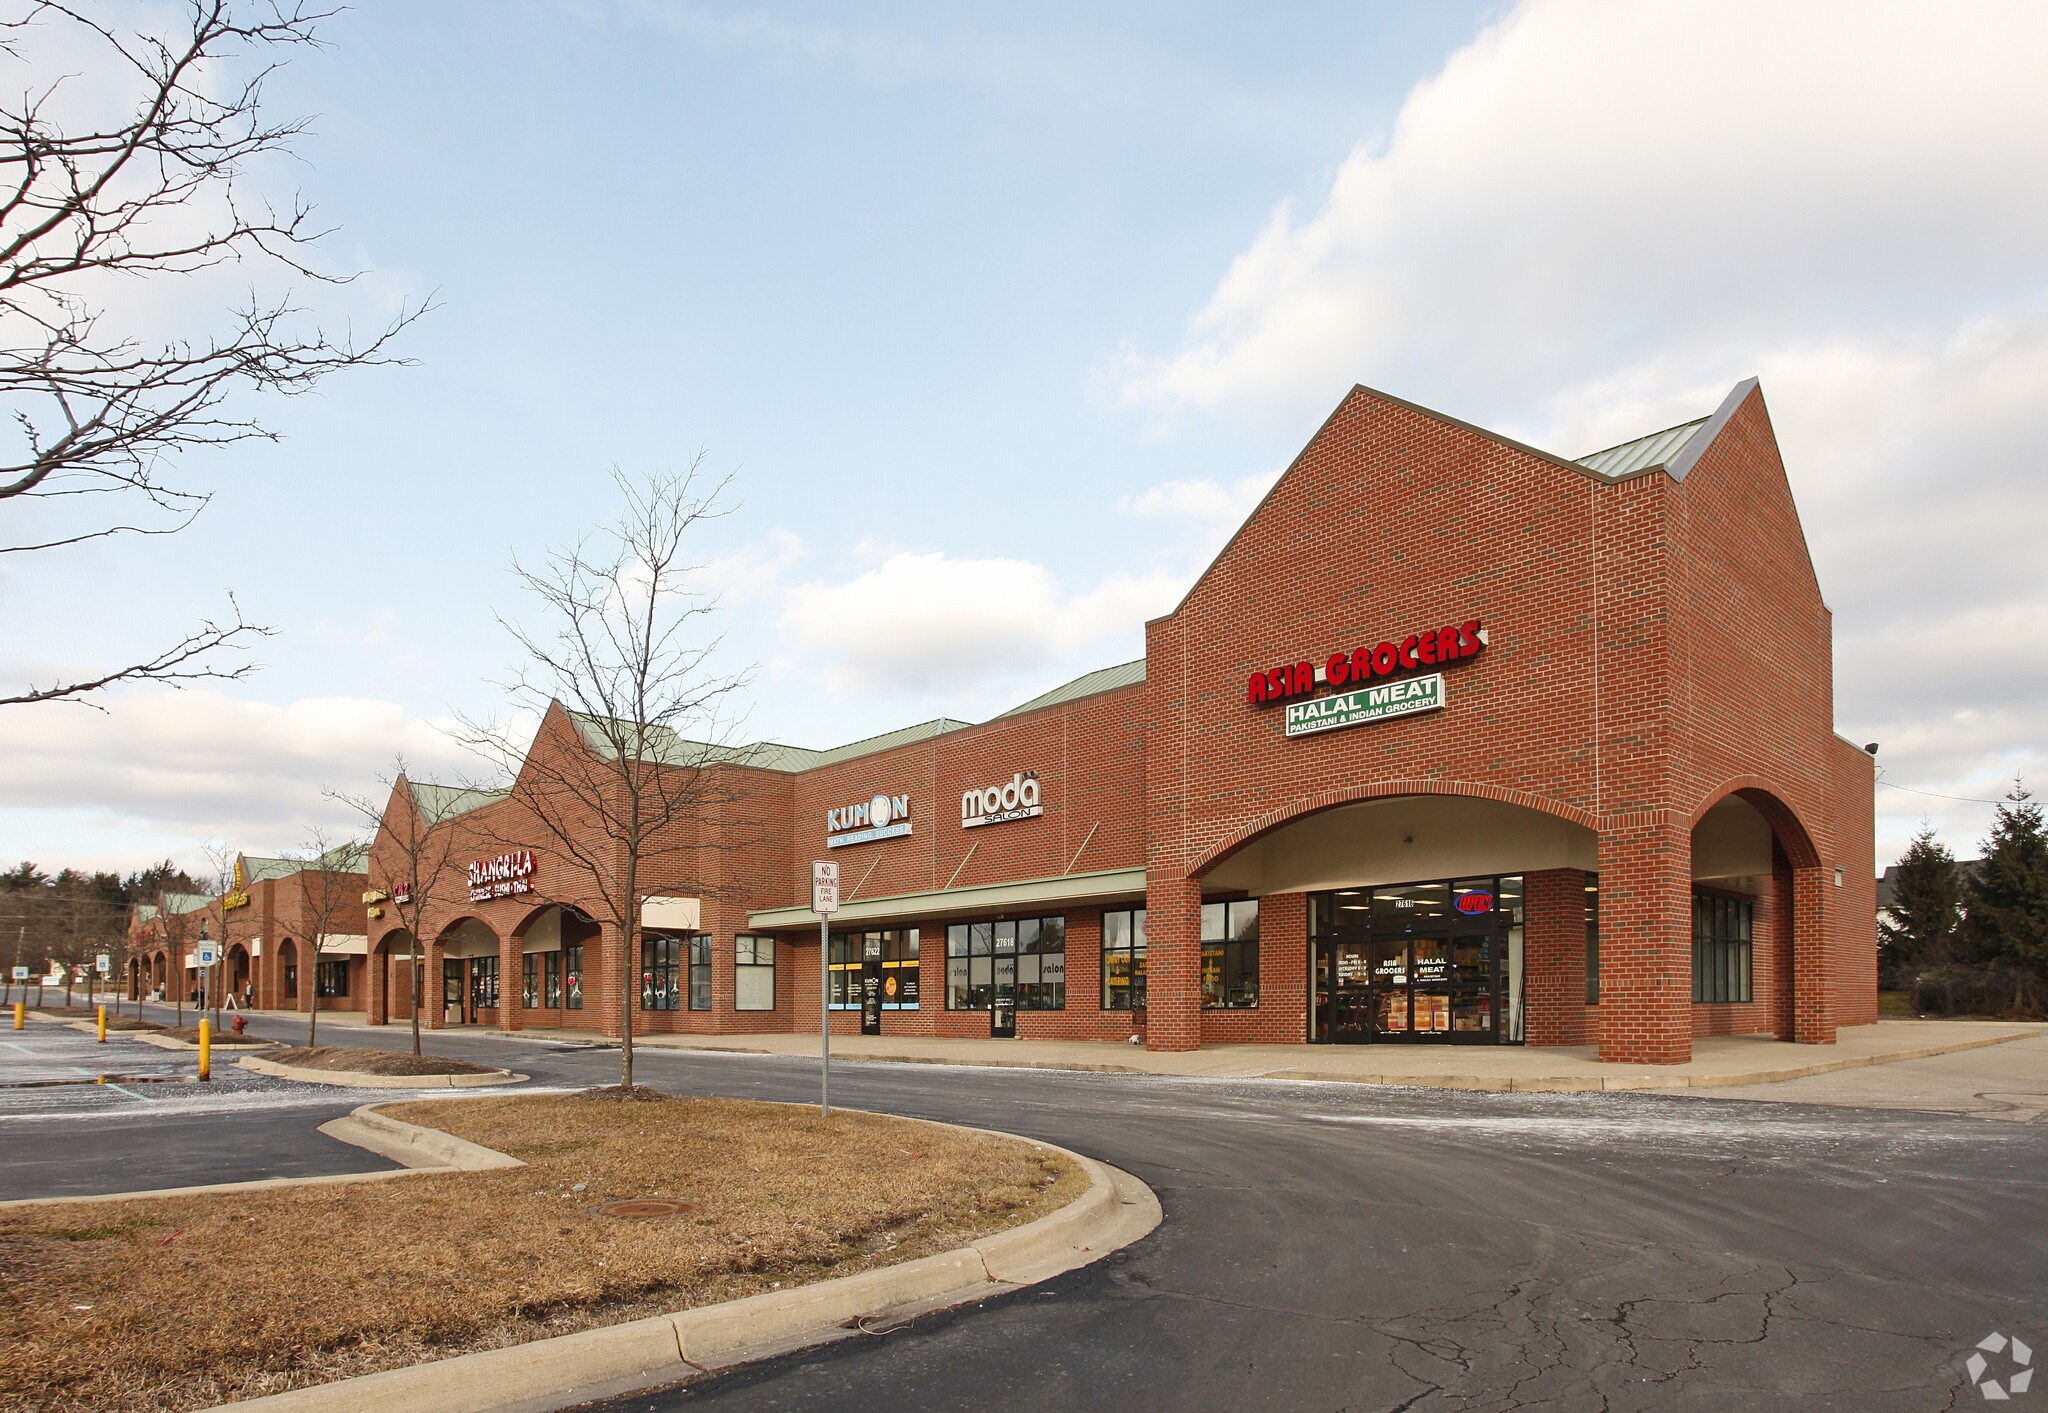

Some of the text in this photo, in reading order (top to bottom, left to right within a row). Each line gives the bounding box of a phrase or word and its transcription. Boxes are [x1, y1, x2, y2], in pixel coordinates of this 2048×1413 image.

[1249, 620, 1481, 703] ASIA GROCERS
[1290, 677, 1437, 722] HALAL MEAT
[1290, 716, 1337, 733] PAKISTANI
[1349, 707, 1383, 720] INDIAN
[1385, 696, 1436, 713] GROCERY
[828, 794, 908, 832] KUMON
[984, 809, 1031, 823] SALON
[467, 851, 532, 887] SHANGRI-LA
[821, 865, 830, 876] NO
[815, 876, 837, 887] PARKING
[820, 887, 832, 895] FIRE
[819, 895, 833, 903] LANE
[1459, 894, 1492, 911] OPEN
[996, 938, 1014, 948] 27618
[865, 947, 880, 956] 27622
[1043, 962, 1064, 974] salon
[1375, 967, 1405, 975] GROCERS
